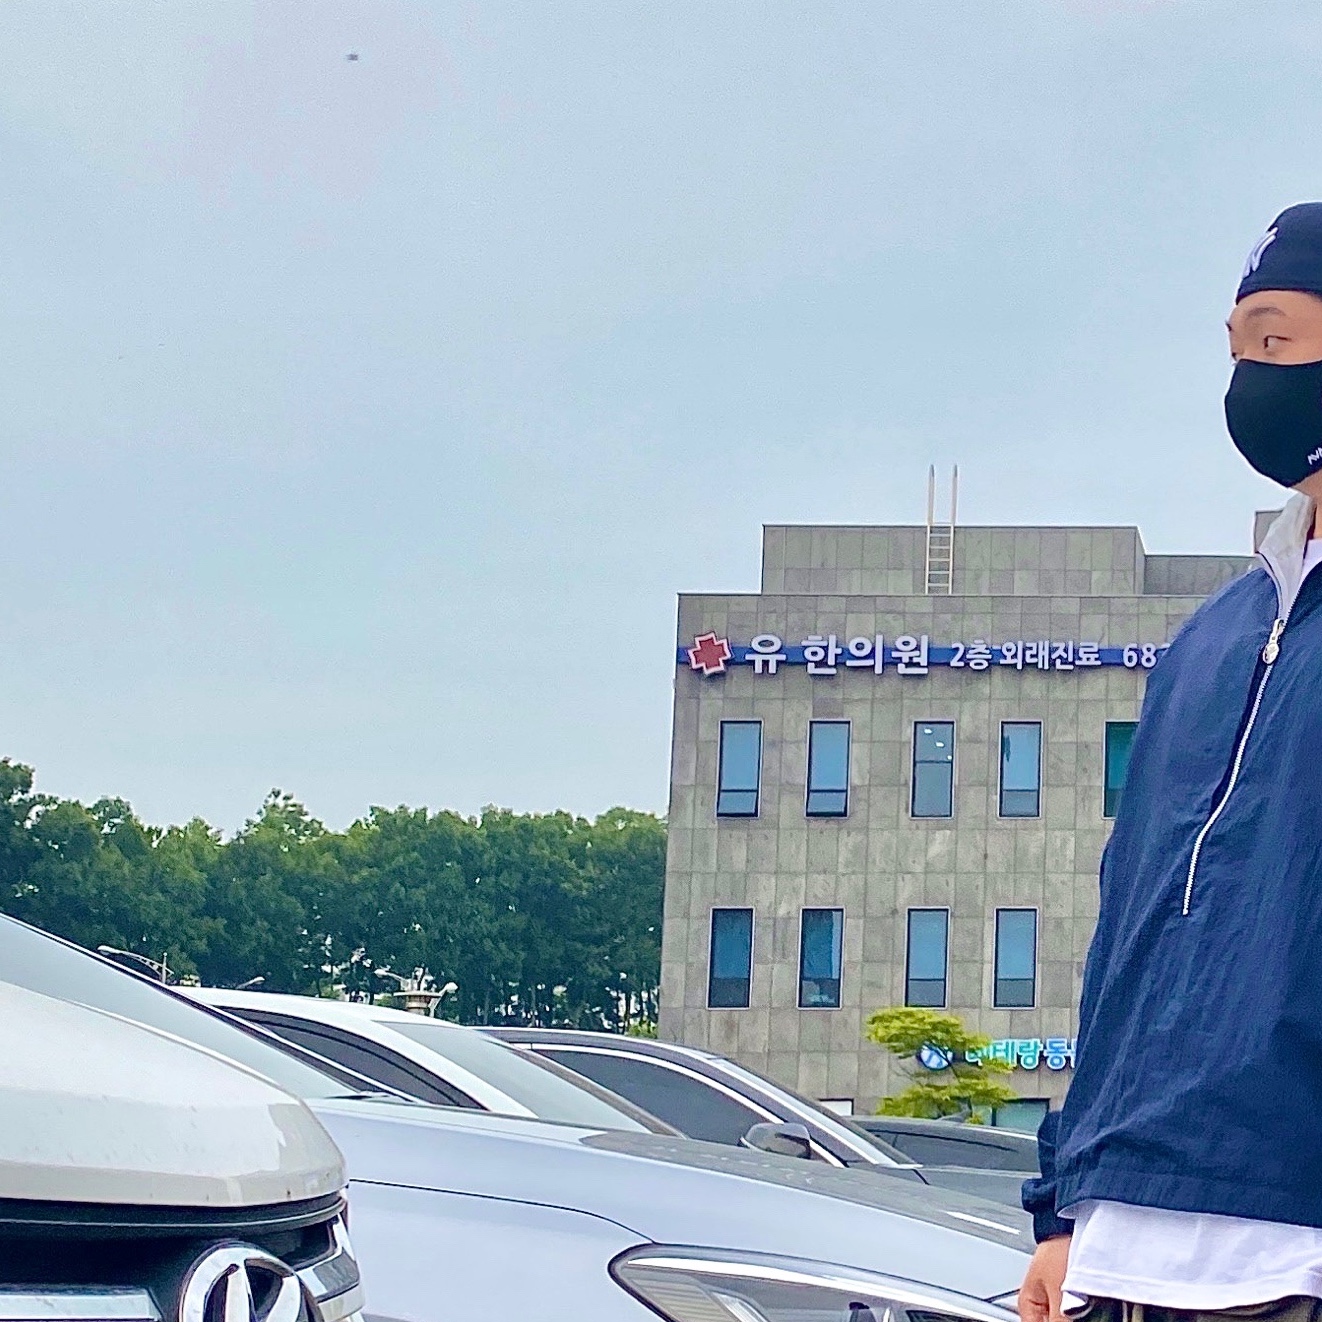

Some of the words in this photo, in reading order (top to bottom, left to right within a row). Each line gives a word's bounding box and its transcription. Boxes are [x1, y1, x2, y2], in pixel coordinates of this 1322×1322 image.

[745, 634, 786, 674] 유
[801, 634, 929, 674] 한의원
[950, 641, 993, 670] 2층
[999, 640, 1101, 670] 외래진료
[1123, 642, 1170, 668] 68
